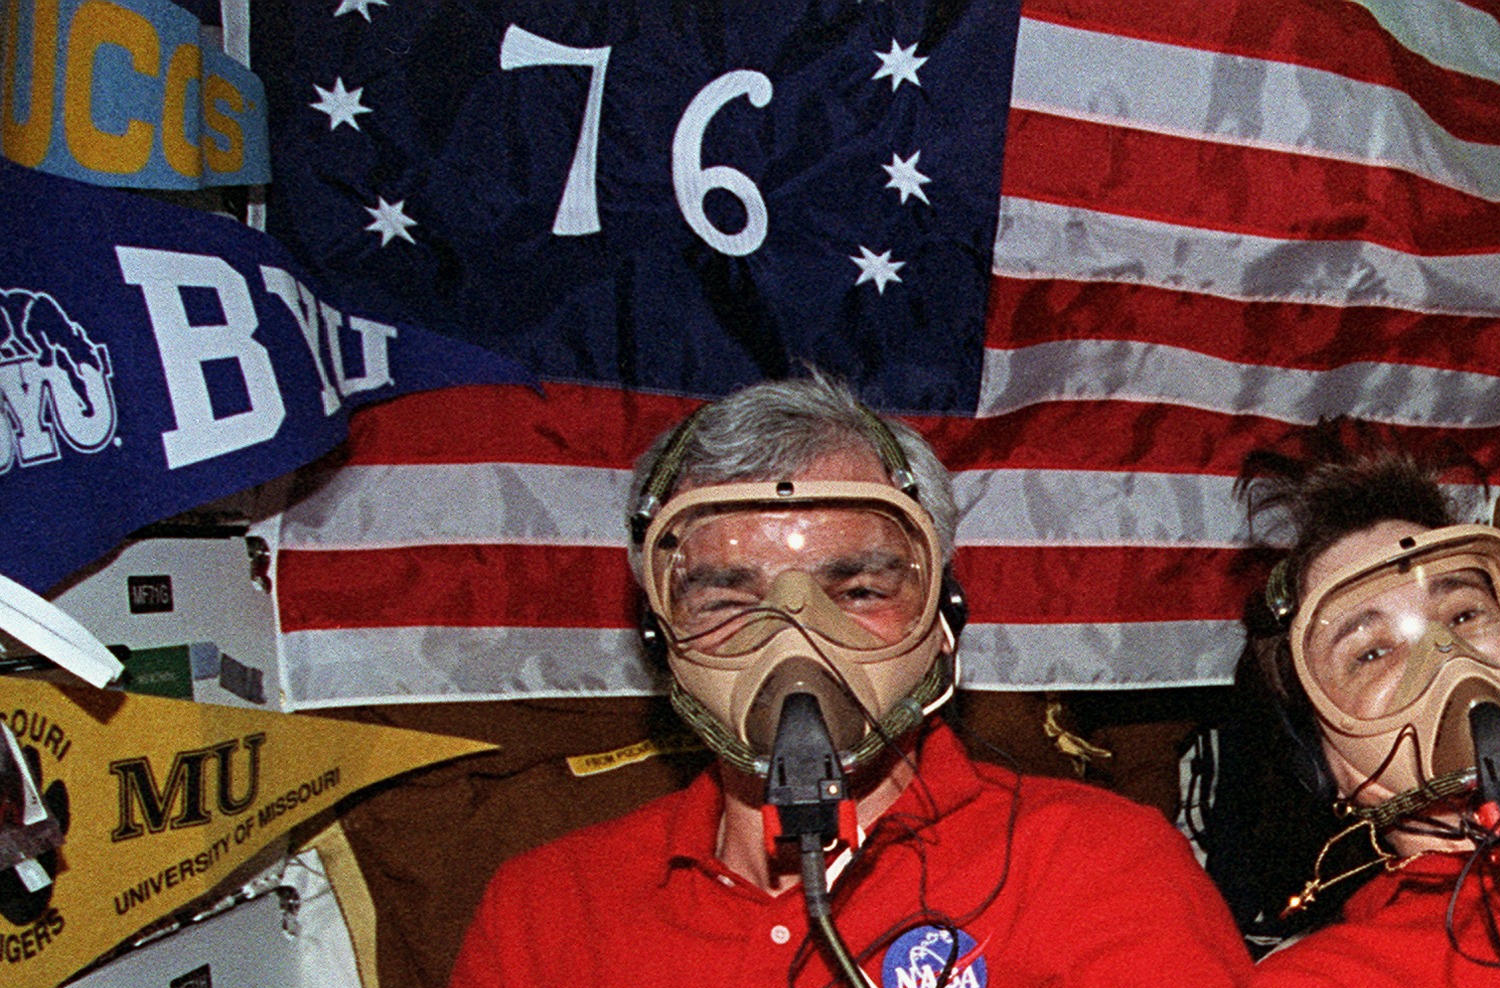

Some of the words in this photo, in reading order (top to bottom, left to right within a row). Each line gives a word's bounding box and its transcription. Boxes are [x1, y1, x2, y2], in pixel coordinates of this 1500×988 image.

[501, 24, 773, 256] 76
[115, 245, 398, 470] BYU
[109, 731, 267, 844] MU
[113, 833, 231, 916] UNIVERSITY
[233, 816, 257, 847] OF
[257, 767, 341, 829] MISSOURI
